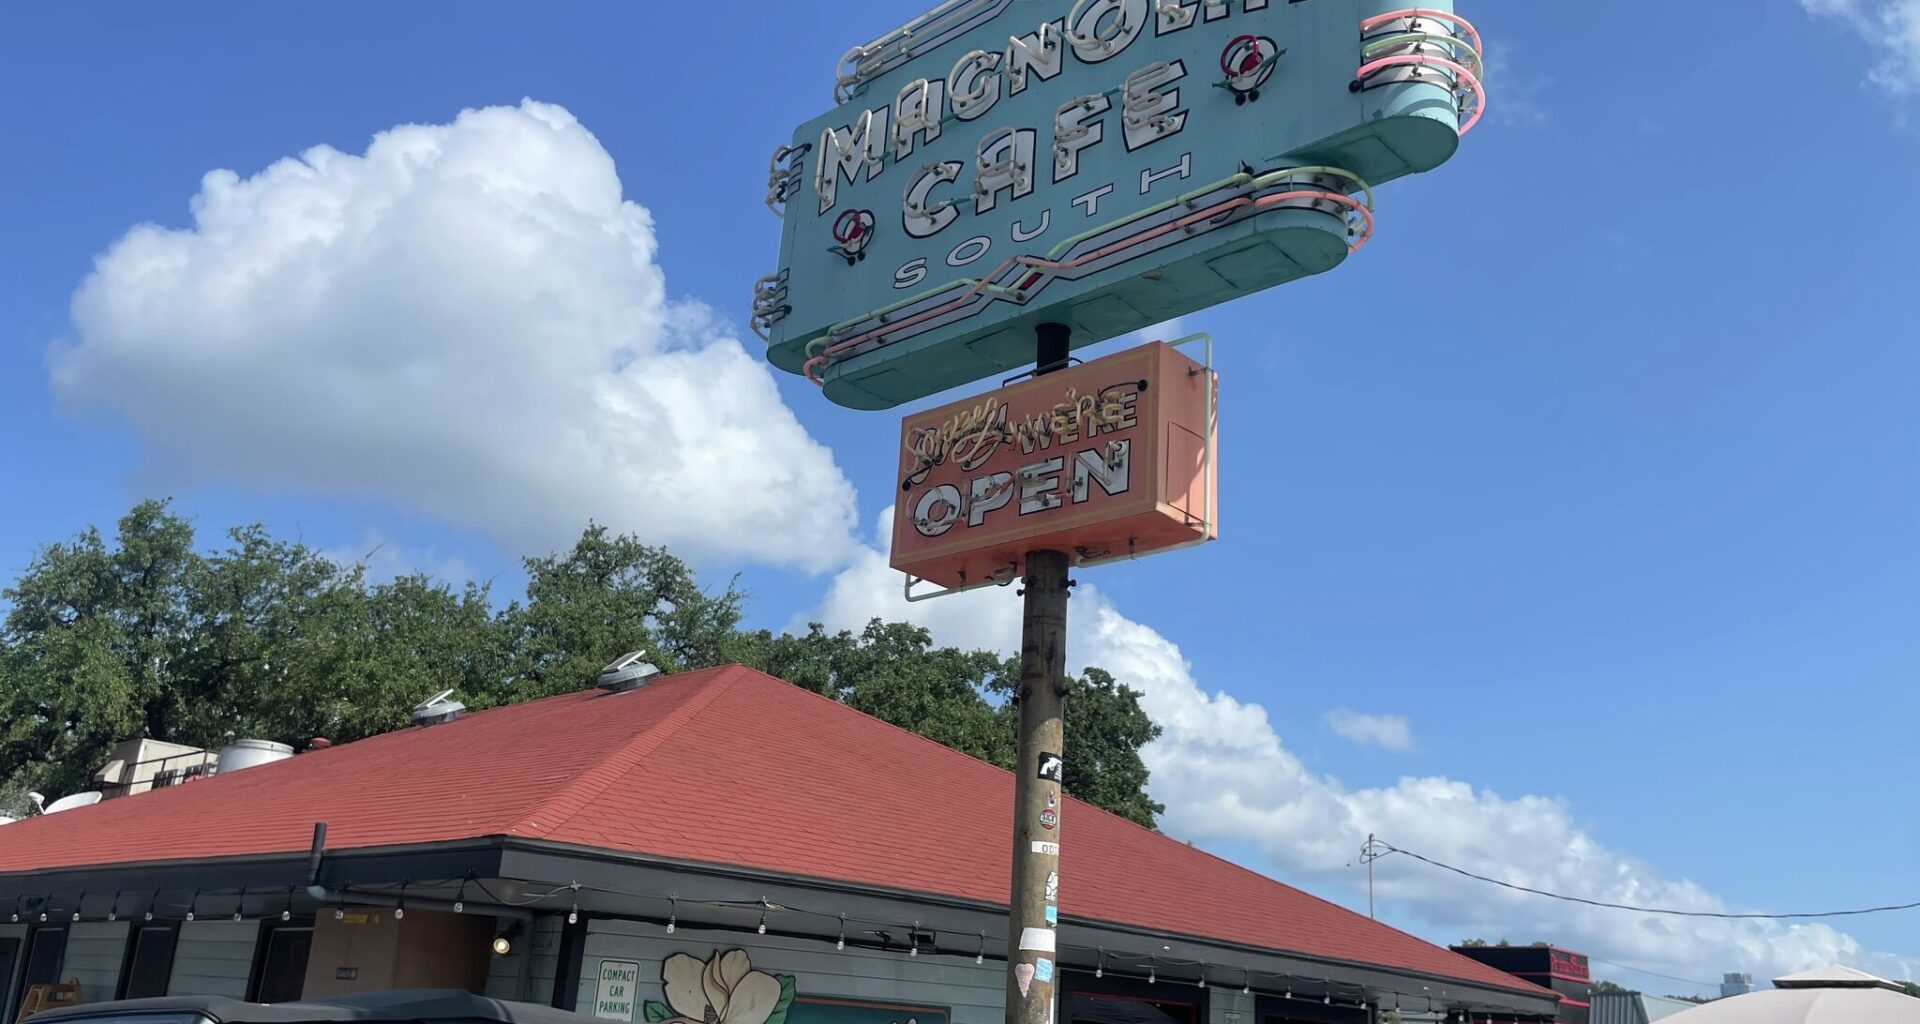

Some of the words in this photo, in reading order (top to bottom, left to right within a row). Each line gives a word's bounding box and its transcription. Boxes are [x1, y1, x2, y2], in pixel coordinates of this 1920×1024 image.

[902, 58, 1190, 239] CAFE
[893, 152, 1192, 289] SOUTH
[908, 438, 1131, 537] OPEN
[602, 968, 636, 982] COMPACT
[609, 985, 625, 998] CAR
[598, 1001, 631, 1014] PARKING
